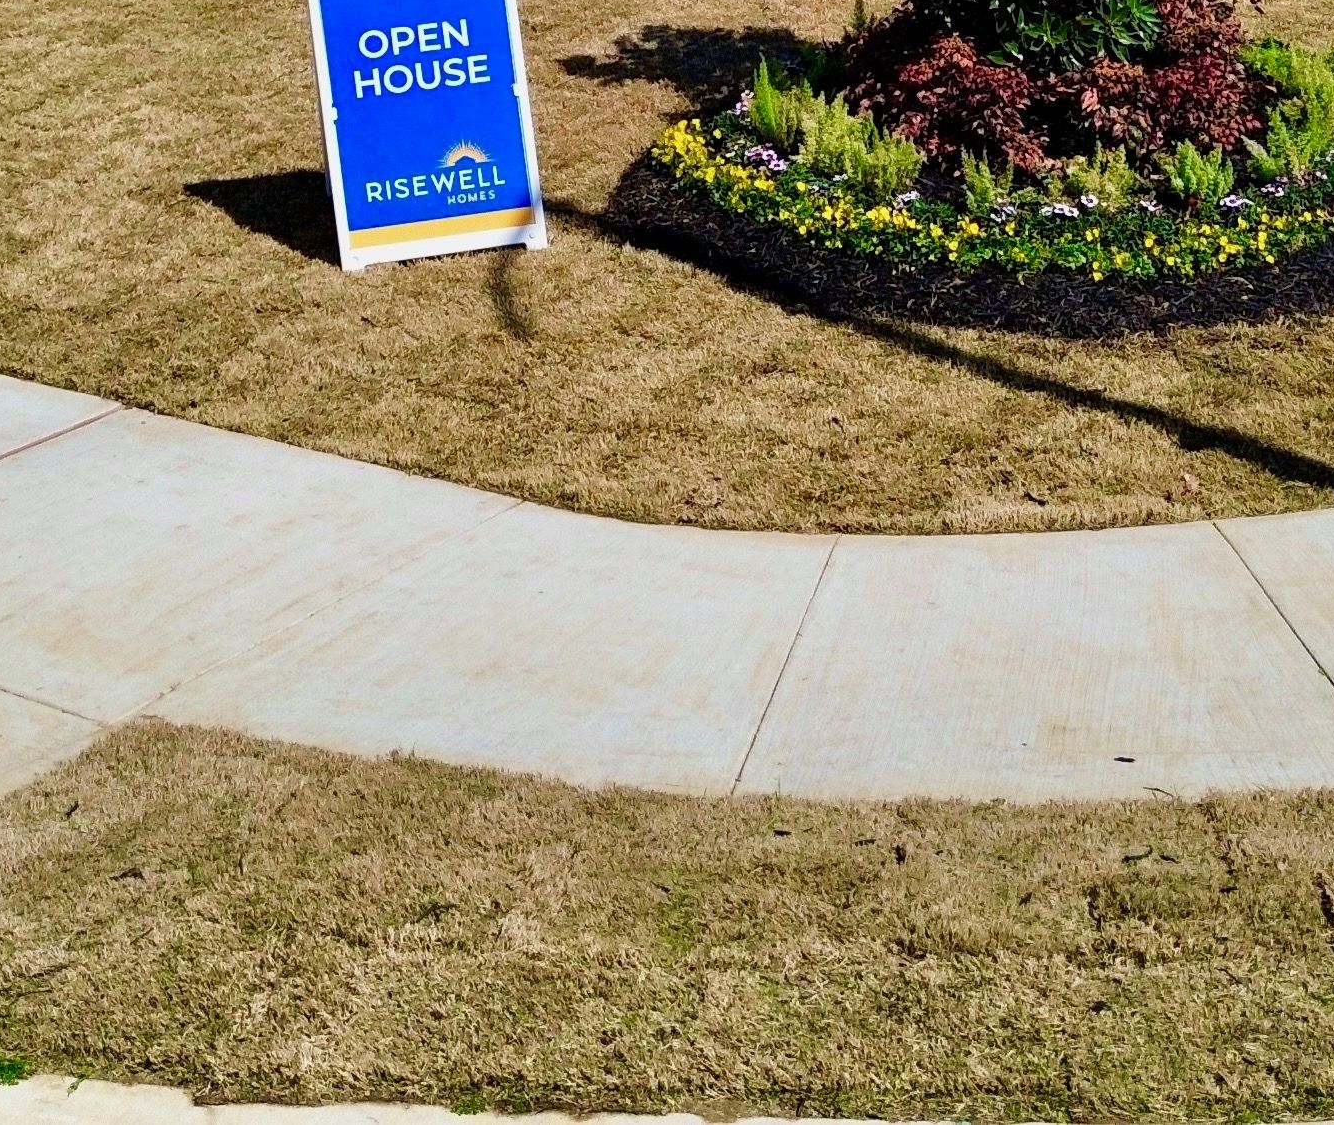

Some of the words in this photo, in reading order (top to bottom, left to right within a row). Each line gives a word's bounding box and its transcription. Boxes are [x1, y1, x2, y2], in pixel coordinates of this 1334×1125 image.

[358, 18, 470, 59] OPEN
[353, 54, 490, 99] HOUSE
[365, 165, 506, 203] RISEWELL
[447, 189, 496, 205] HOMES
